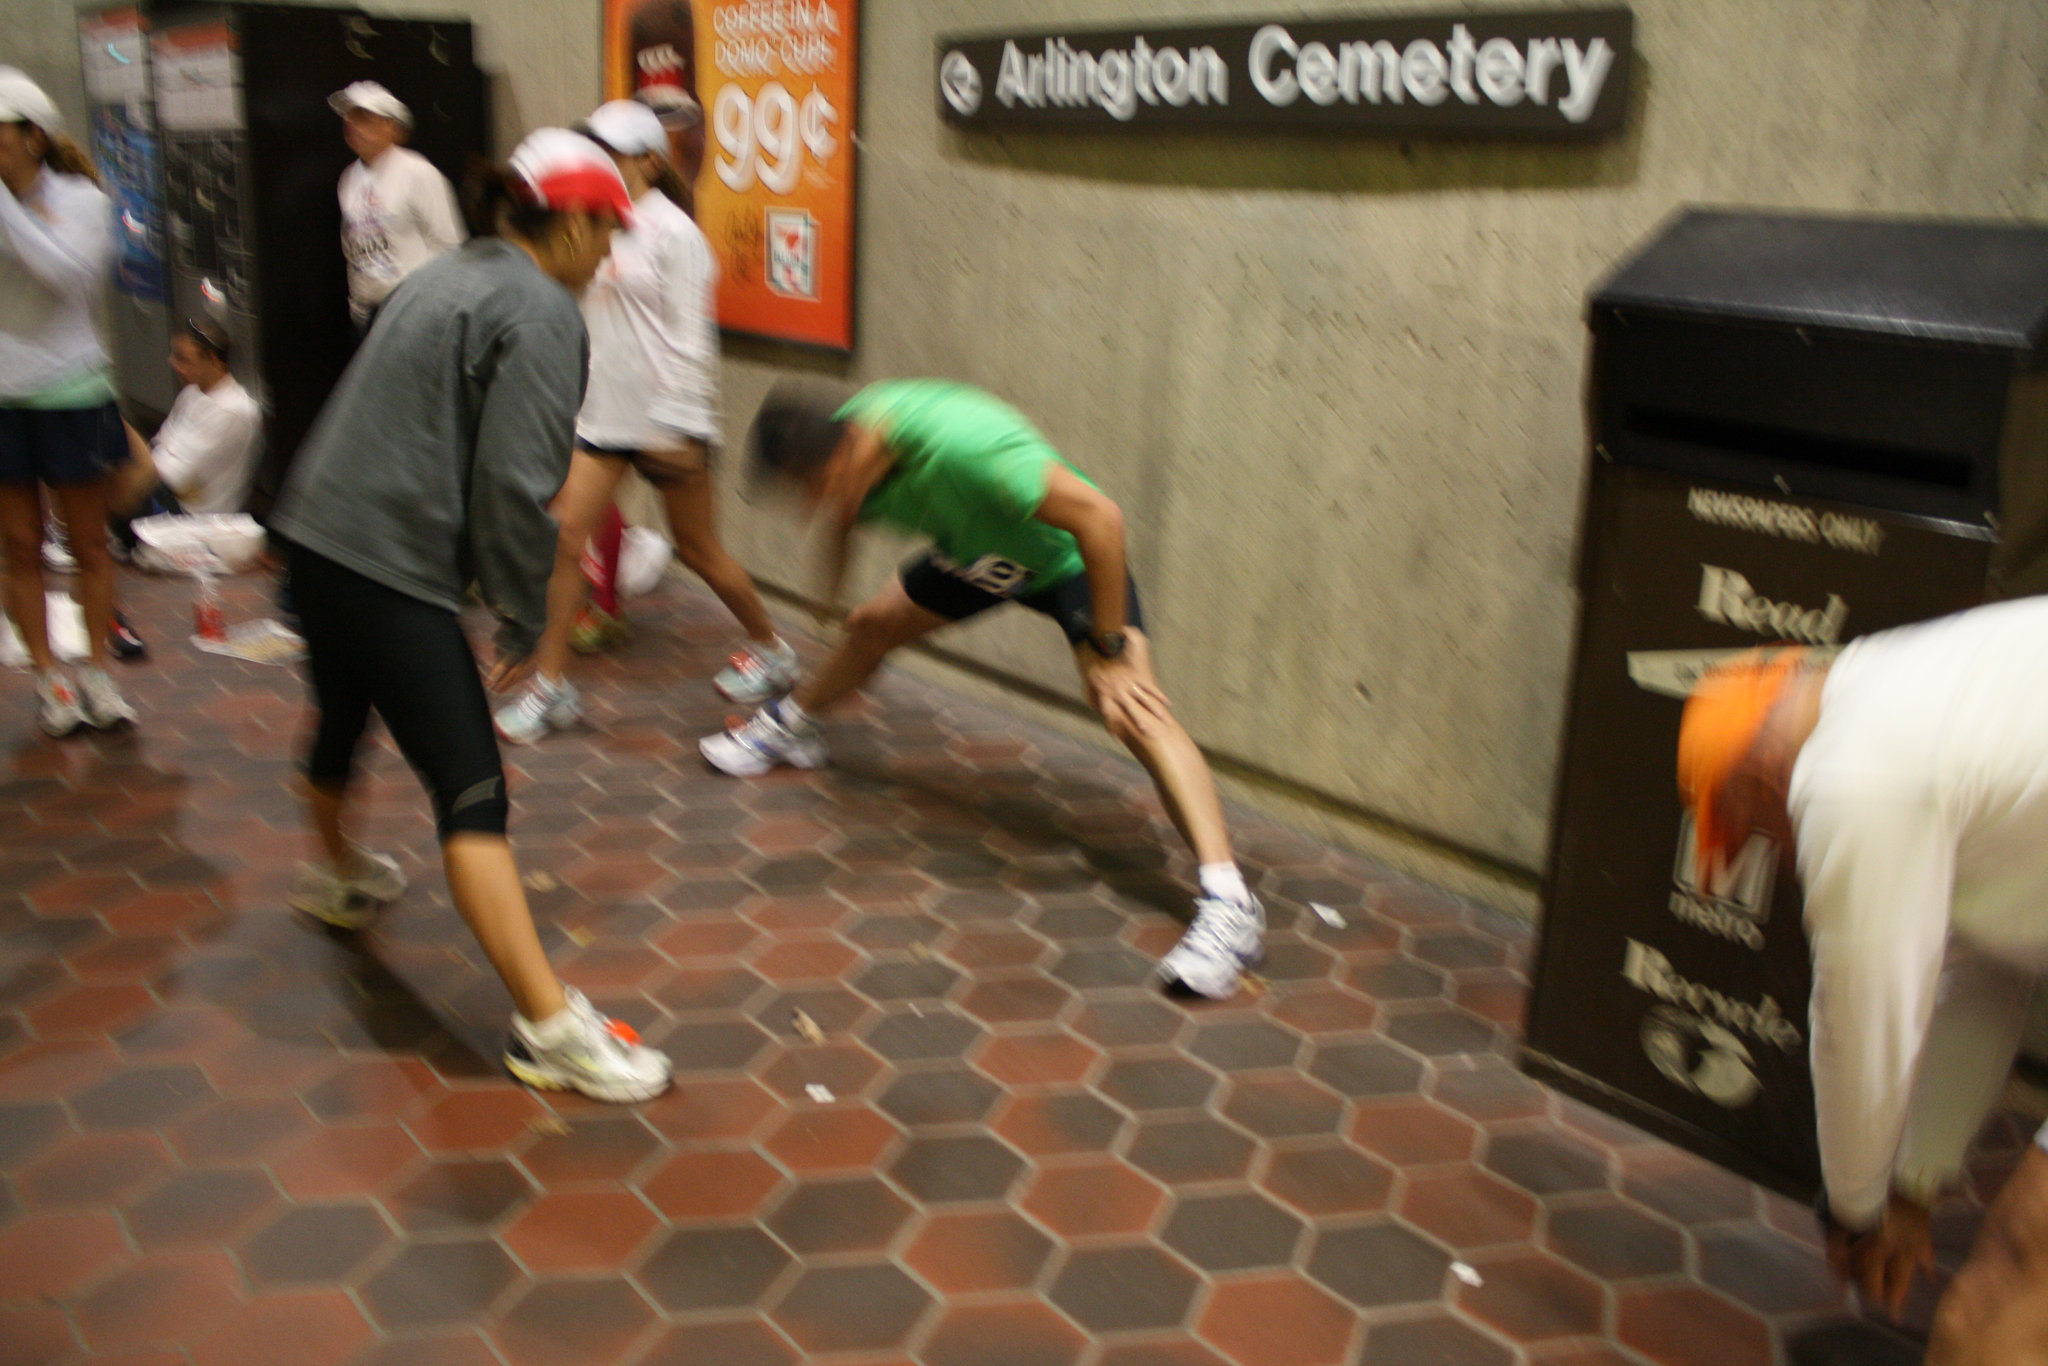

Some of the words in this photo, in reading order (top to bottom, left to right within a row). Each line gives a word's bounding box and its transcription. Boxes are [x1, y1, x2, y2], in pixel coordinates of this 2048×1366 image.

[712, 1, 783, 43] COFFEE
[788, 0, 815, 34] IN
[815, 0, 840, 36] A
[995, 35, 1230, 121] Arlington
[1248, 23, 1614, 122] Cemetery
[712, 80, 839, 195] 99¢
[1696, 561, 1849, 646] Read
